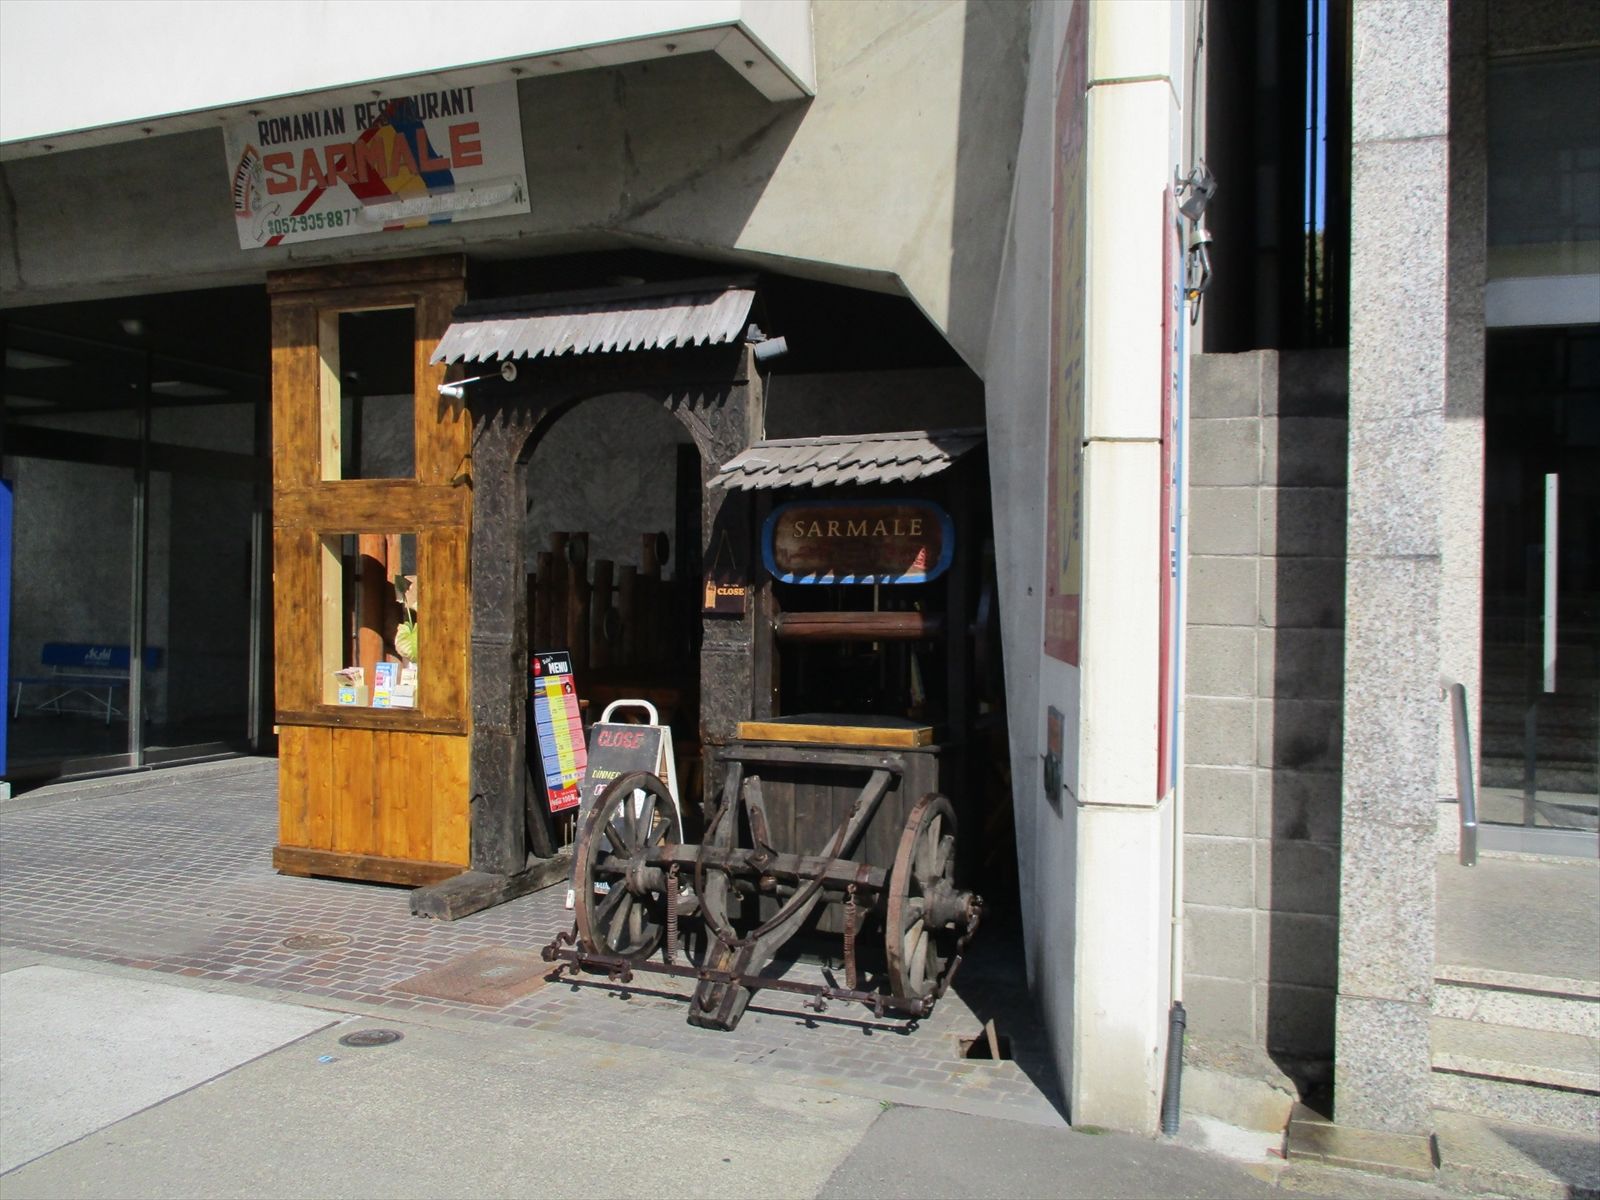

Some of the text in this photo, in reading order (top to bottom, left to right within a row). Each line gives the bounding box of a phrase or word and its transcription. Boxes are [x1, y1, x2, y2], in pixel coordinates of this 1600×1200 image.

[257, 107, 346, 147] ROMANIAN
[263, 121, 484, 195] SARMALE
[793, 518, 923, 538] SARMALE
[717, 587, 745, 596] CLOSE
[548, 661, 569, 675] MENU
[598, 730, 645, 749] CLOSE
